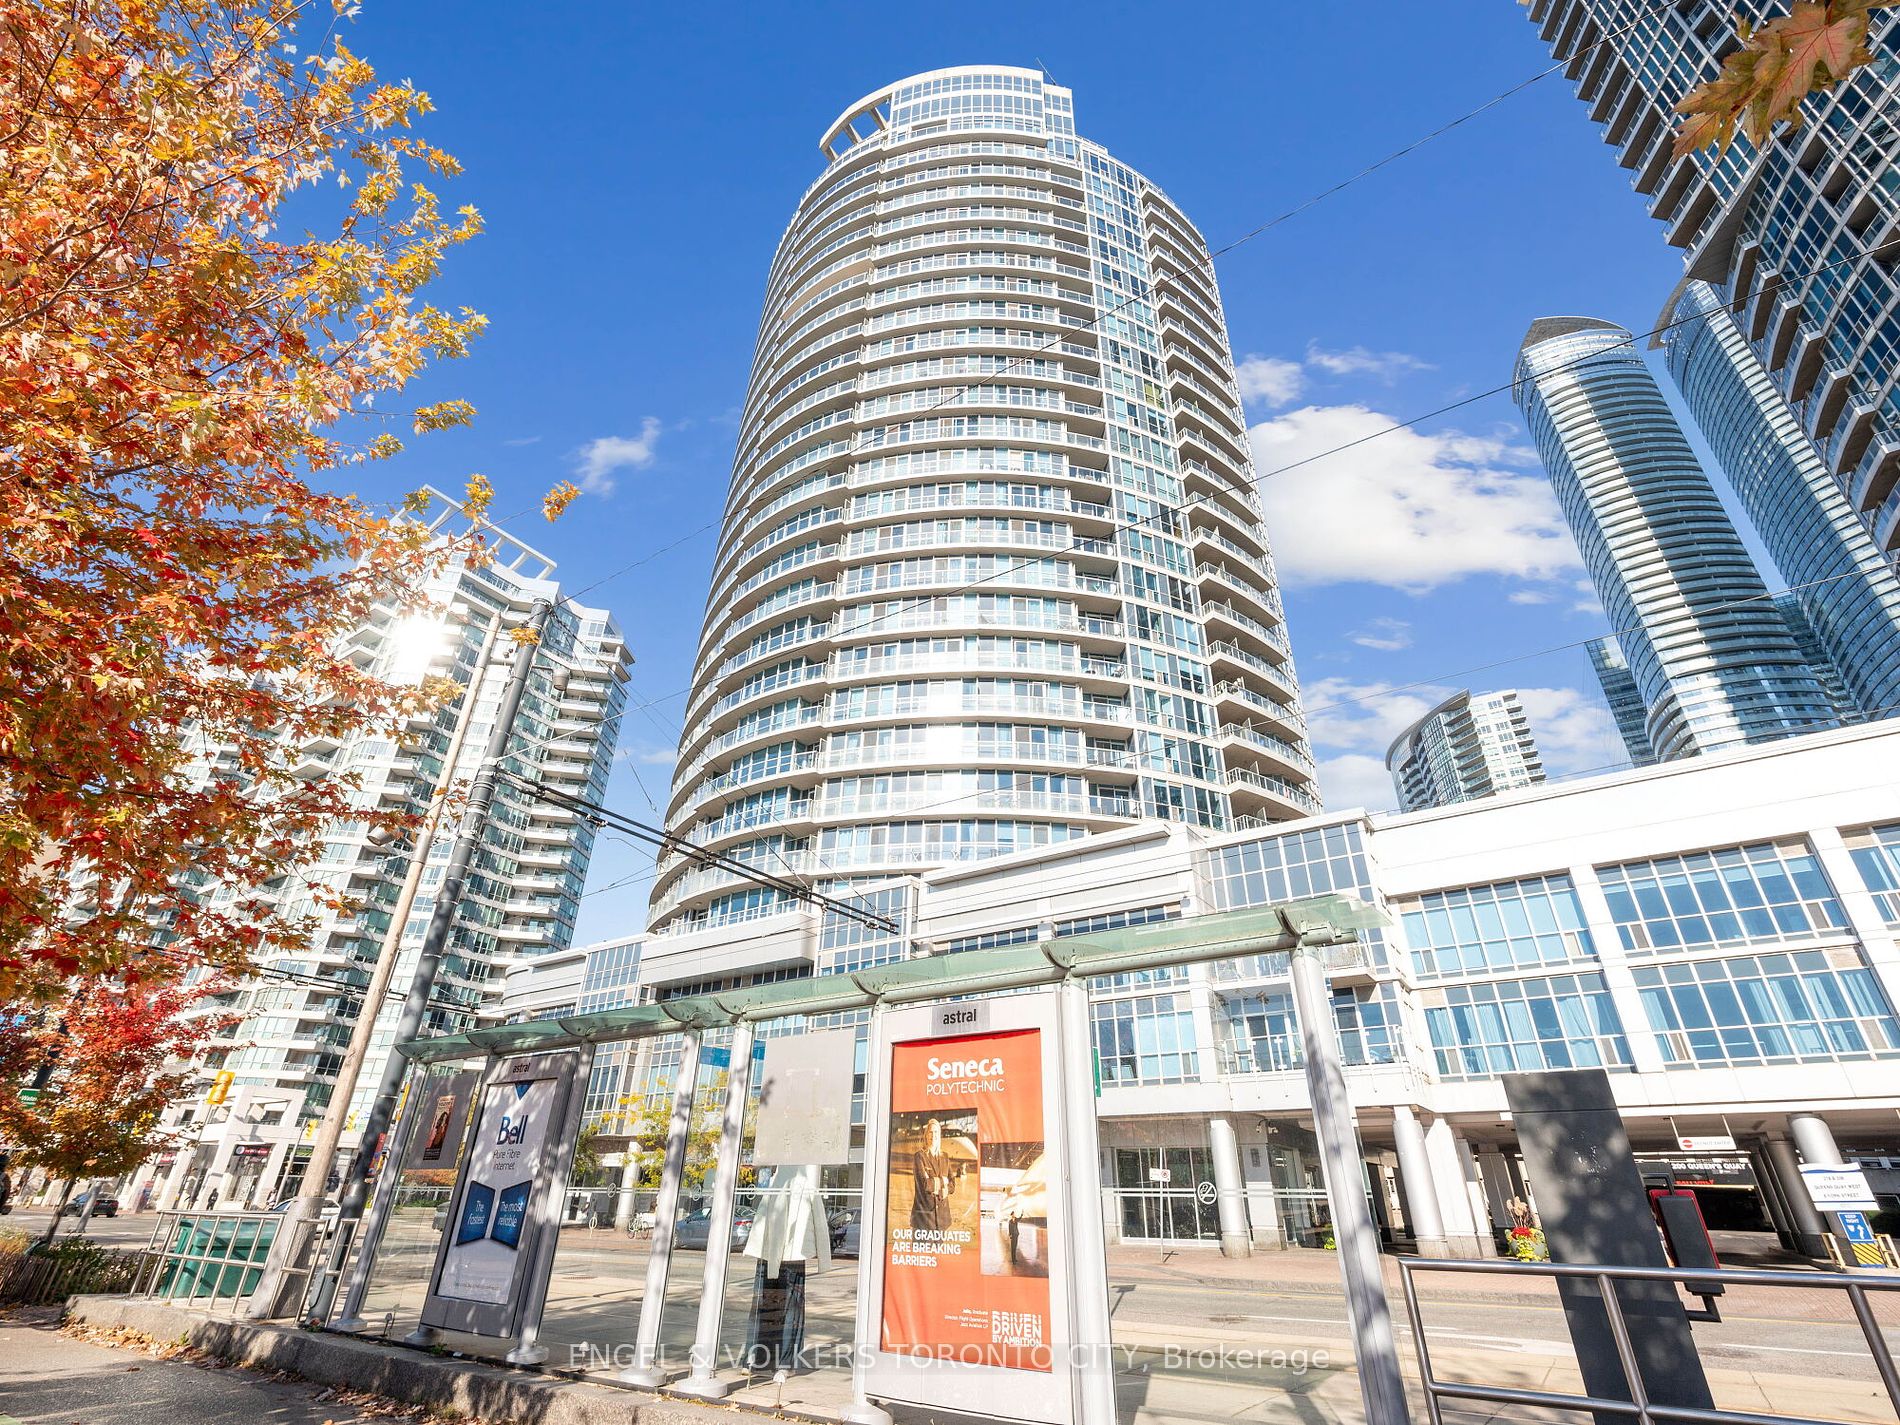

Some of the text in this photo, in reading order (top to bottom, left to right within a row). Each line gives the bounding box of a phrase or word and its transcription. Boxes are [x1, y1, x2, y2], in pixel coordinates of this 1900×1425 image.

[943, 1009, 977, 1025] astral
[512, 1062, 531, 1074] astral
[927, 1057, 1004, 1080] Seneca
[926, 1079, 1005, 1096] POLYTECHNIC
[496, 1114, 528, 1145] Bell
[892, 1229, 971, 1242] OUR GRADUATES
[892, 1241, 961, 1255] ARE BREAKING
[892, 1254, 937, 1268] BARRIERS
[992, 1320, 1042, 1339] DRIVEN
[992, 1334, 1042, 1348] BY AMBITION
